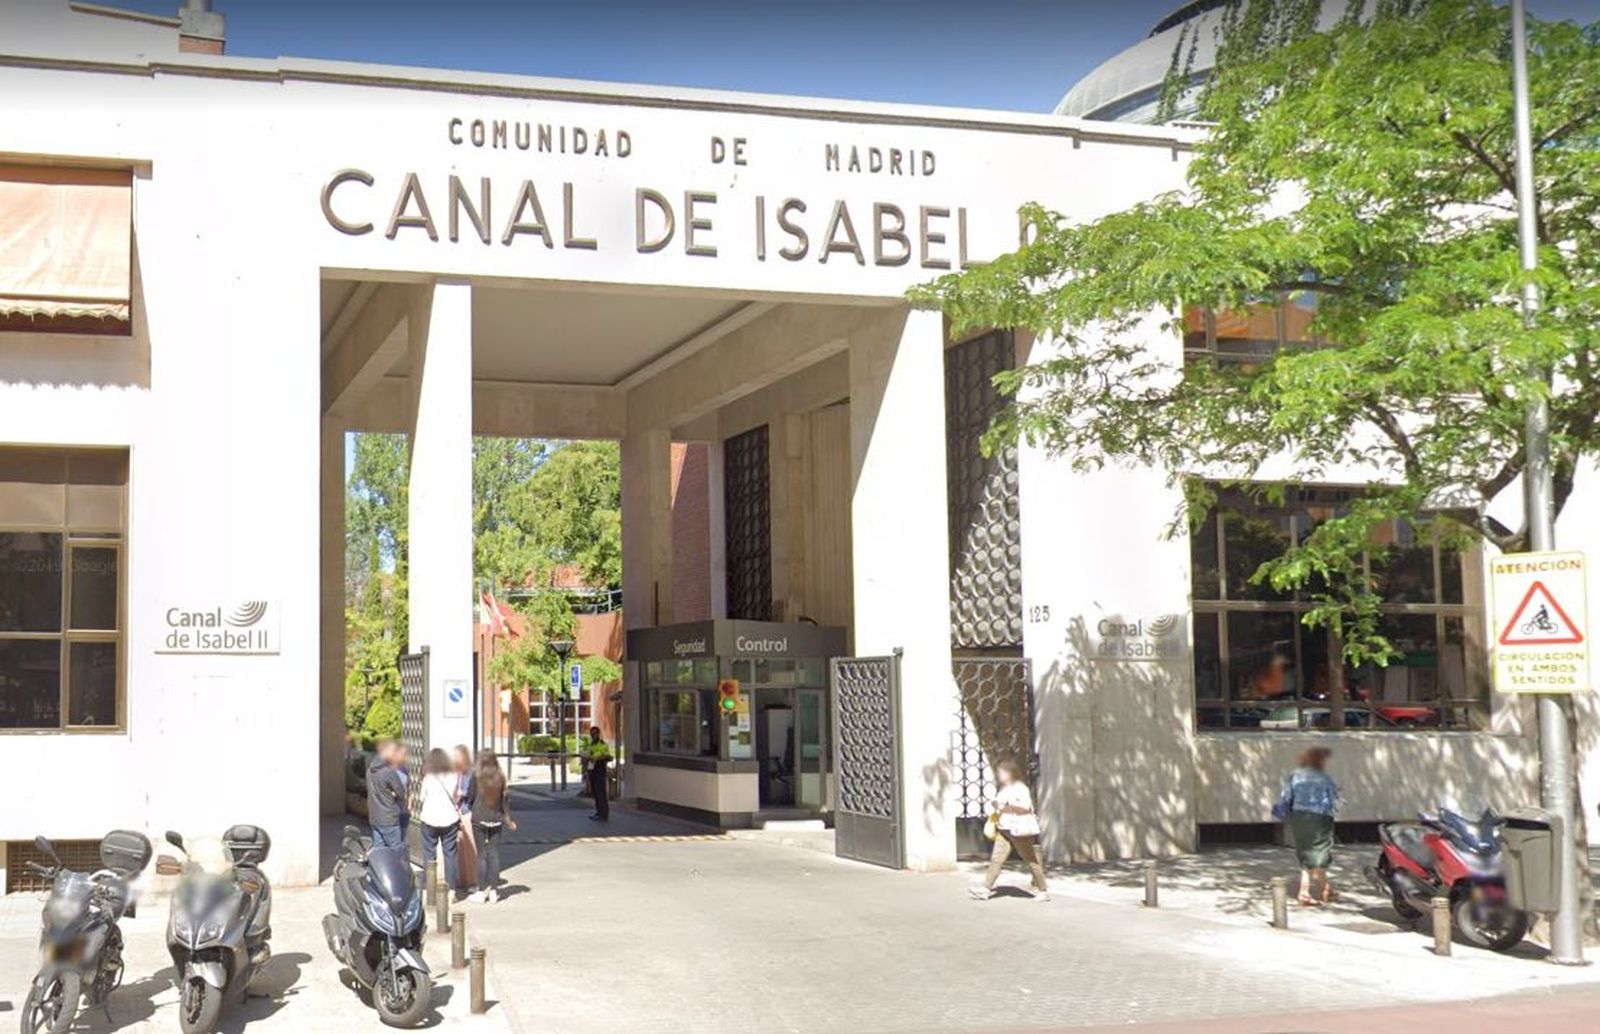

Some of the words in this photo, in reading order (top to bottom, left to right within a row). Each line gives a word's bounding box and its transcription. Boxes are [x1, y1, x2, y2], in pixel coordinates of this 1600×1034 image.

[449, 117, 632, 158] COMUNIDAD
[711, 136, 748, 166] DE
[825, 143, 937, 177] MADRID
[320, 168, 598, 250] CANAL
[635, 187, 718, 258] DE
[755, 195, 994, 271] ISABEL
[166, 606, 222, 628] Canal
[1029, 605, 1051, 624] 125
[1097, 619, 1143, 638] Canal
[165, 629, 190, 649] de
[196, 629, 252, 649] Isabel
[736, 636, 788, 652] Control
[1098, 639, 1118, 657] de
[1508, 664, 1525, 674] EN
[1532, 663, 1578, 674] AMBOS
[1511, 675, 1576, 685] SENTIDOS
